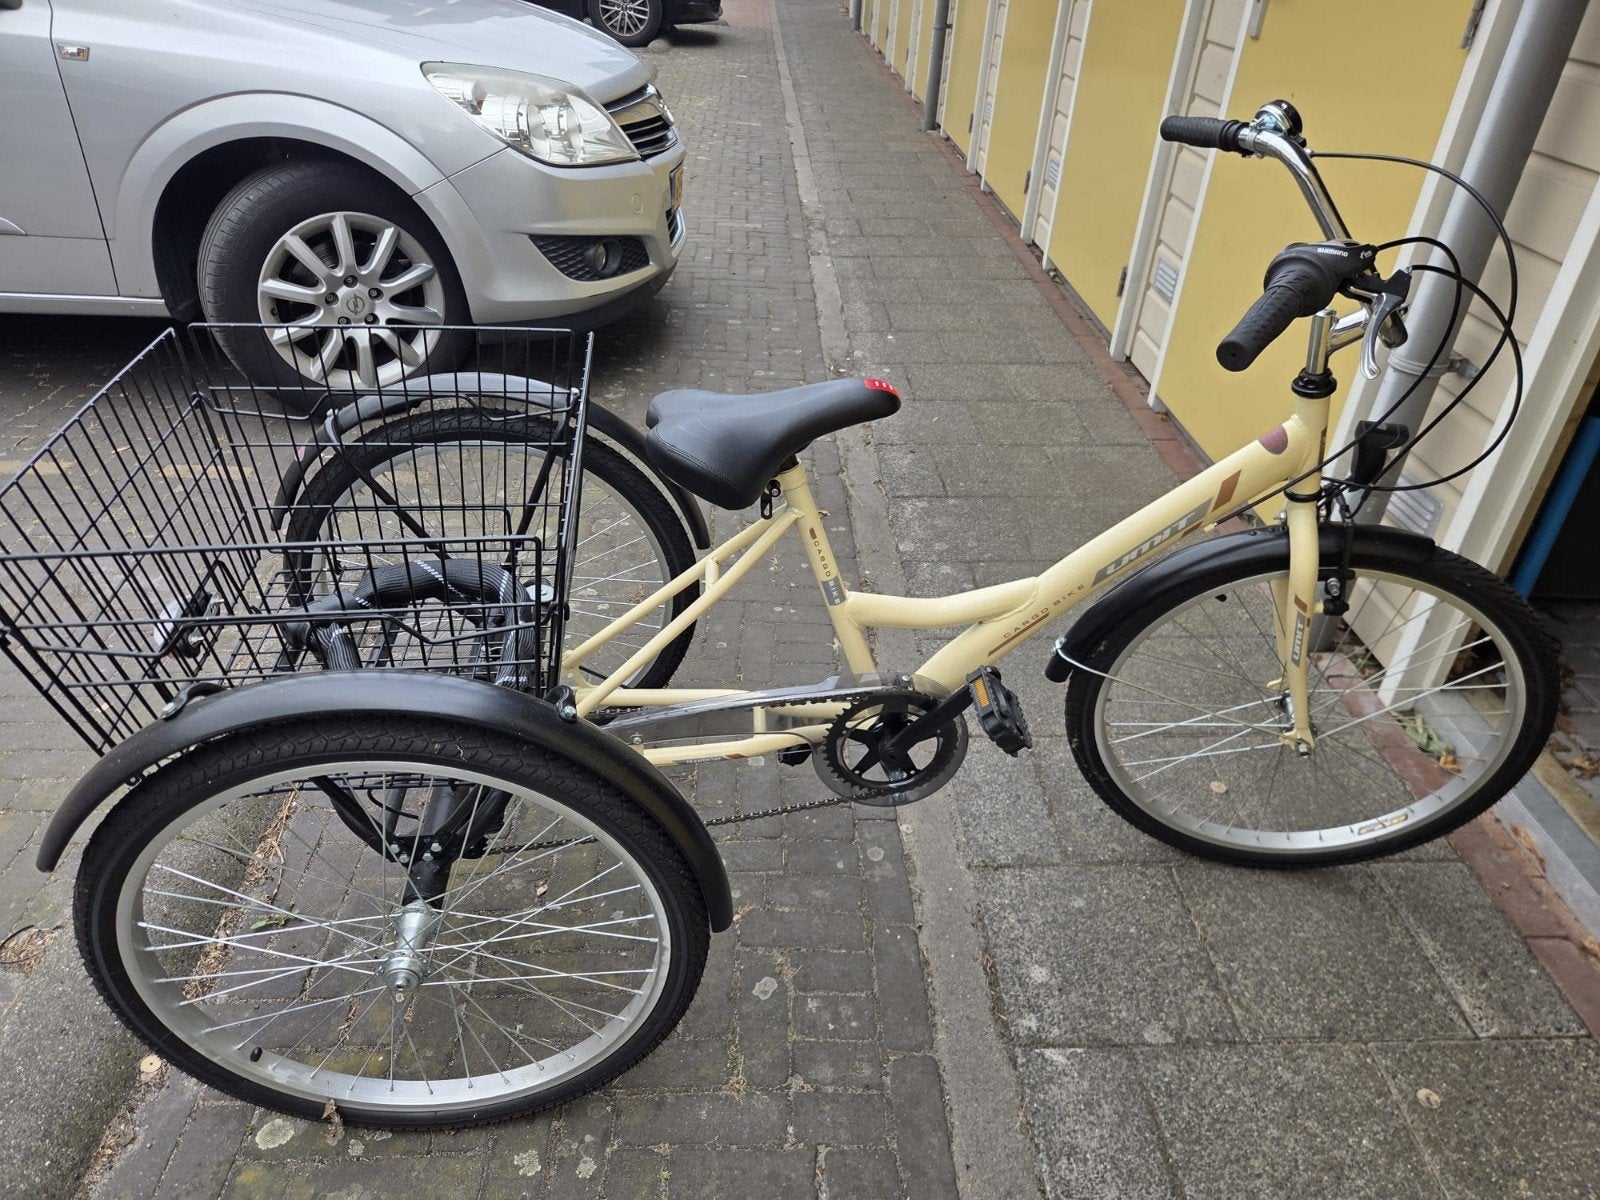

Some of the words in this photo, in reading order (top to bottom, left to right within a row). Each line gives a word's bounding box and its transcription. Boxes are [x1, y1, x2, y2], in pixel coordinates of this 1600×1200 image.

[1316, 247, 1349, 258] SHIMANO
[813, 540, 831, 577] CARGO
[828, 580, 841, 605] BIKE
[1003, 608, 1049, 639] CARGO
[1053, 585, 1086, 606] BIKE
